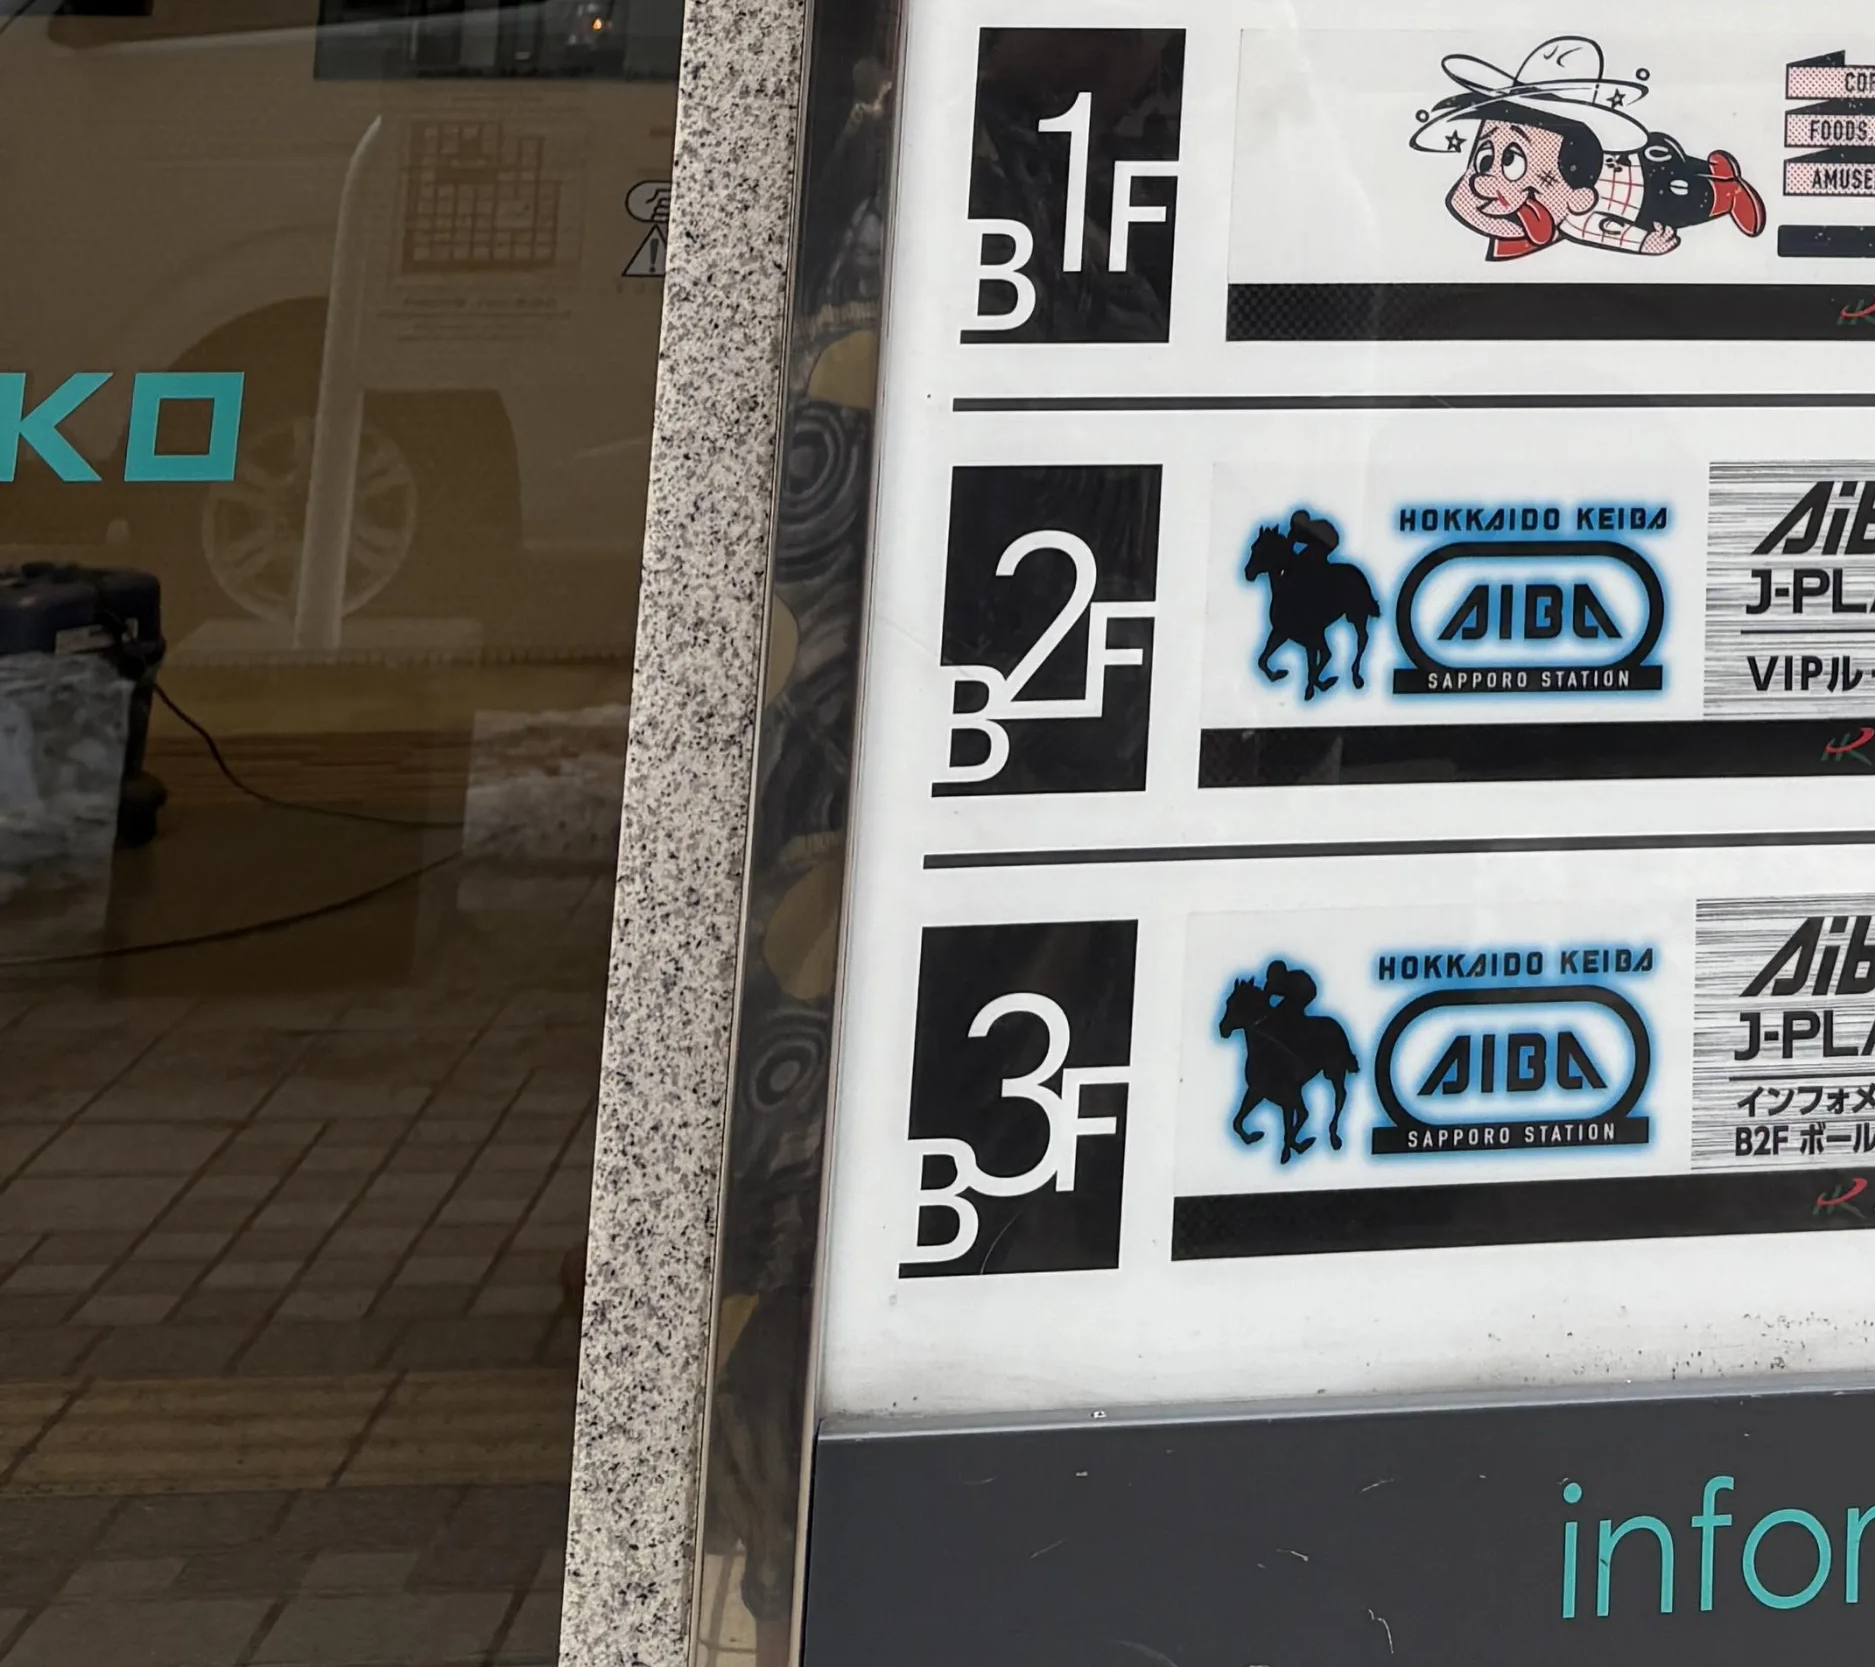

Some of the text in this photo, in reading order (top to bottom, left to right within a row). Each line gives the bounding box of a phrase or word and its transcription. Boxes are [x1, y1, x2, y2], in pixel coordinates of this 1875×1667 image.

[1399, 506, 1560, 533] HOKKAIDO
[1427, 669, 1631, 691] SAPPORO STATION
[1378, 951, 1544, 982] HOKKAIDO
[1407, 1122, 1617, 1149] SAPPORO STATION
[1734, 1125, 1789, 1158] B2F
